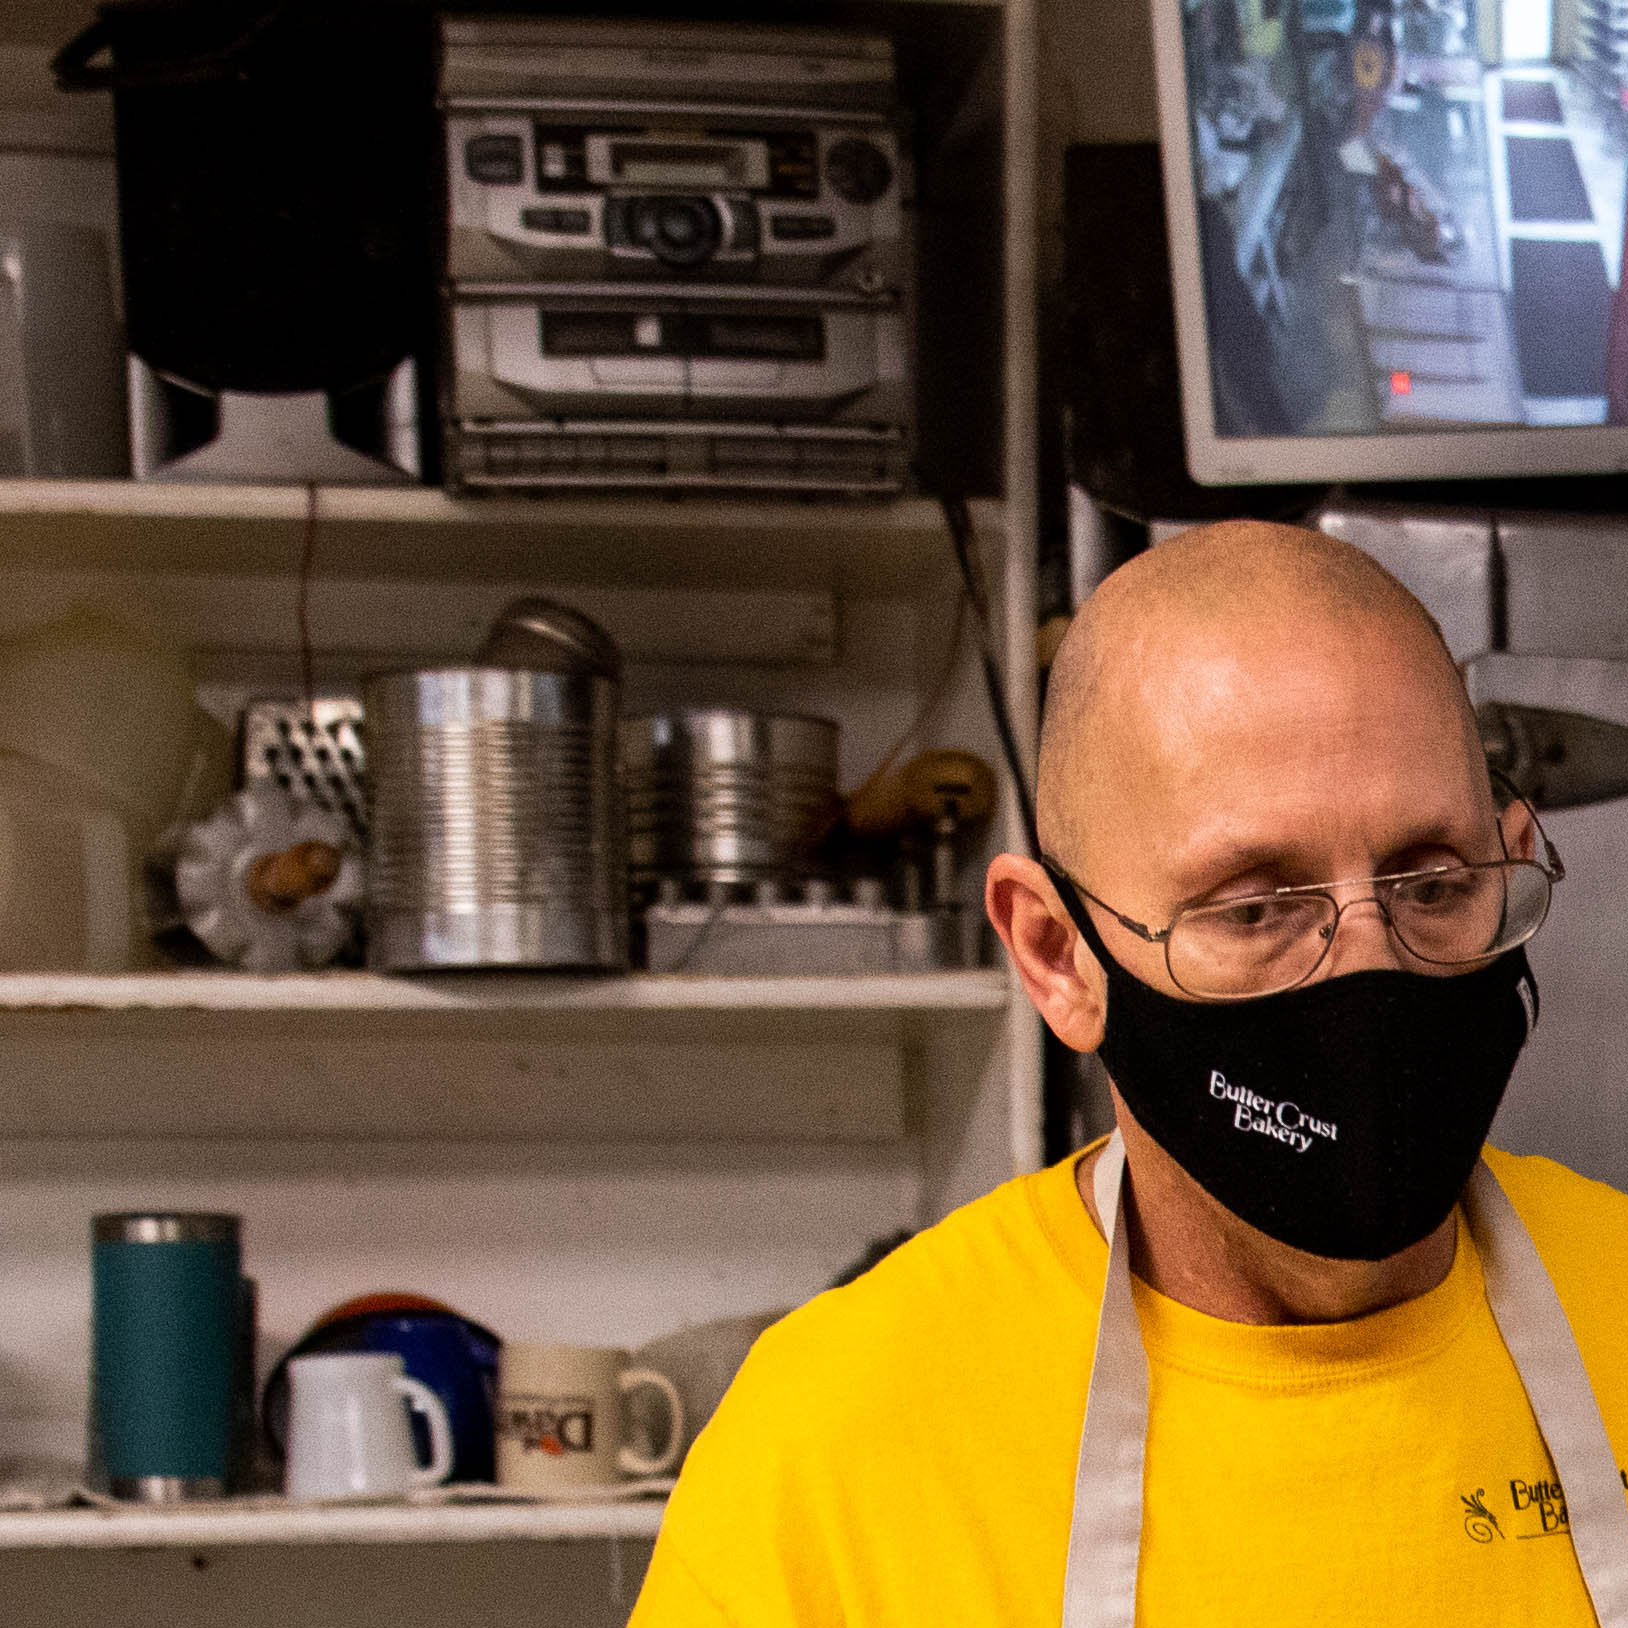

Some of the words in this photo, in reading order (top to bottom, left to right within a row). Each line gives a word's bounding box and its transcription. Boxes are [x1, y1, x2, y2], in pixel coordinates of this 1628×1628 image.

[1234, 1103, 1313, 1153] Bakery
[1275, 1101, 1338, 1141] Crust
[1510, 1479, 1567, 1510] Butte
